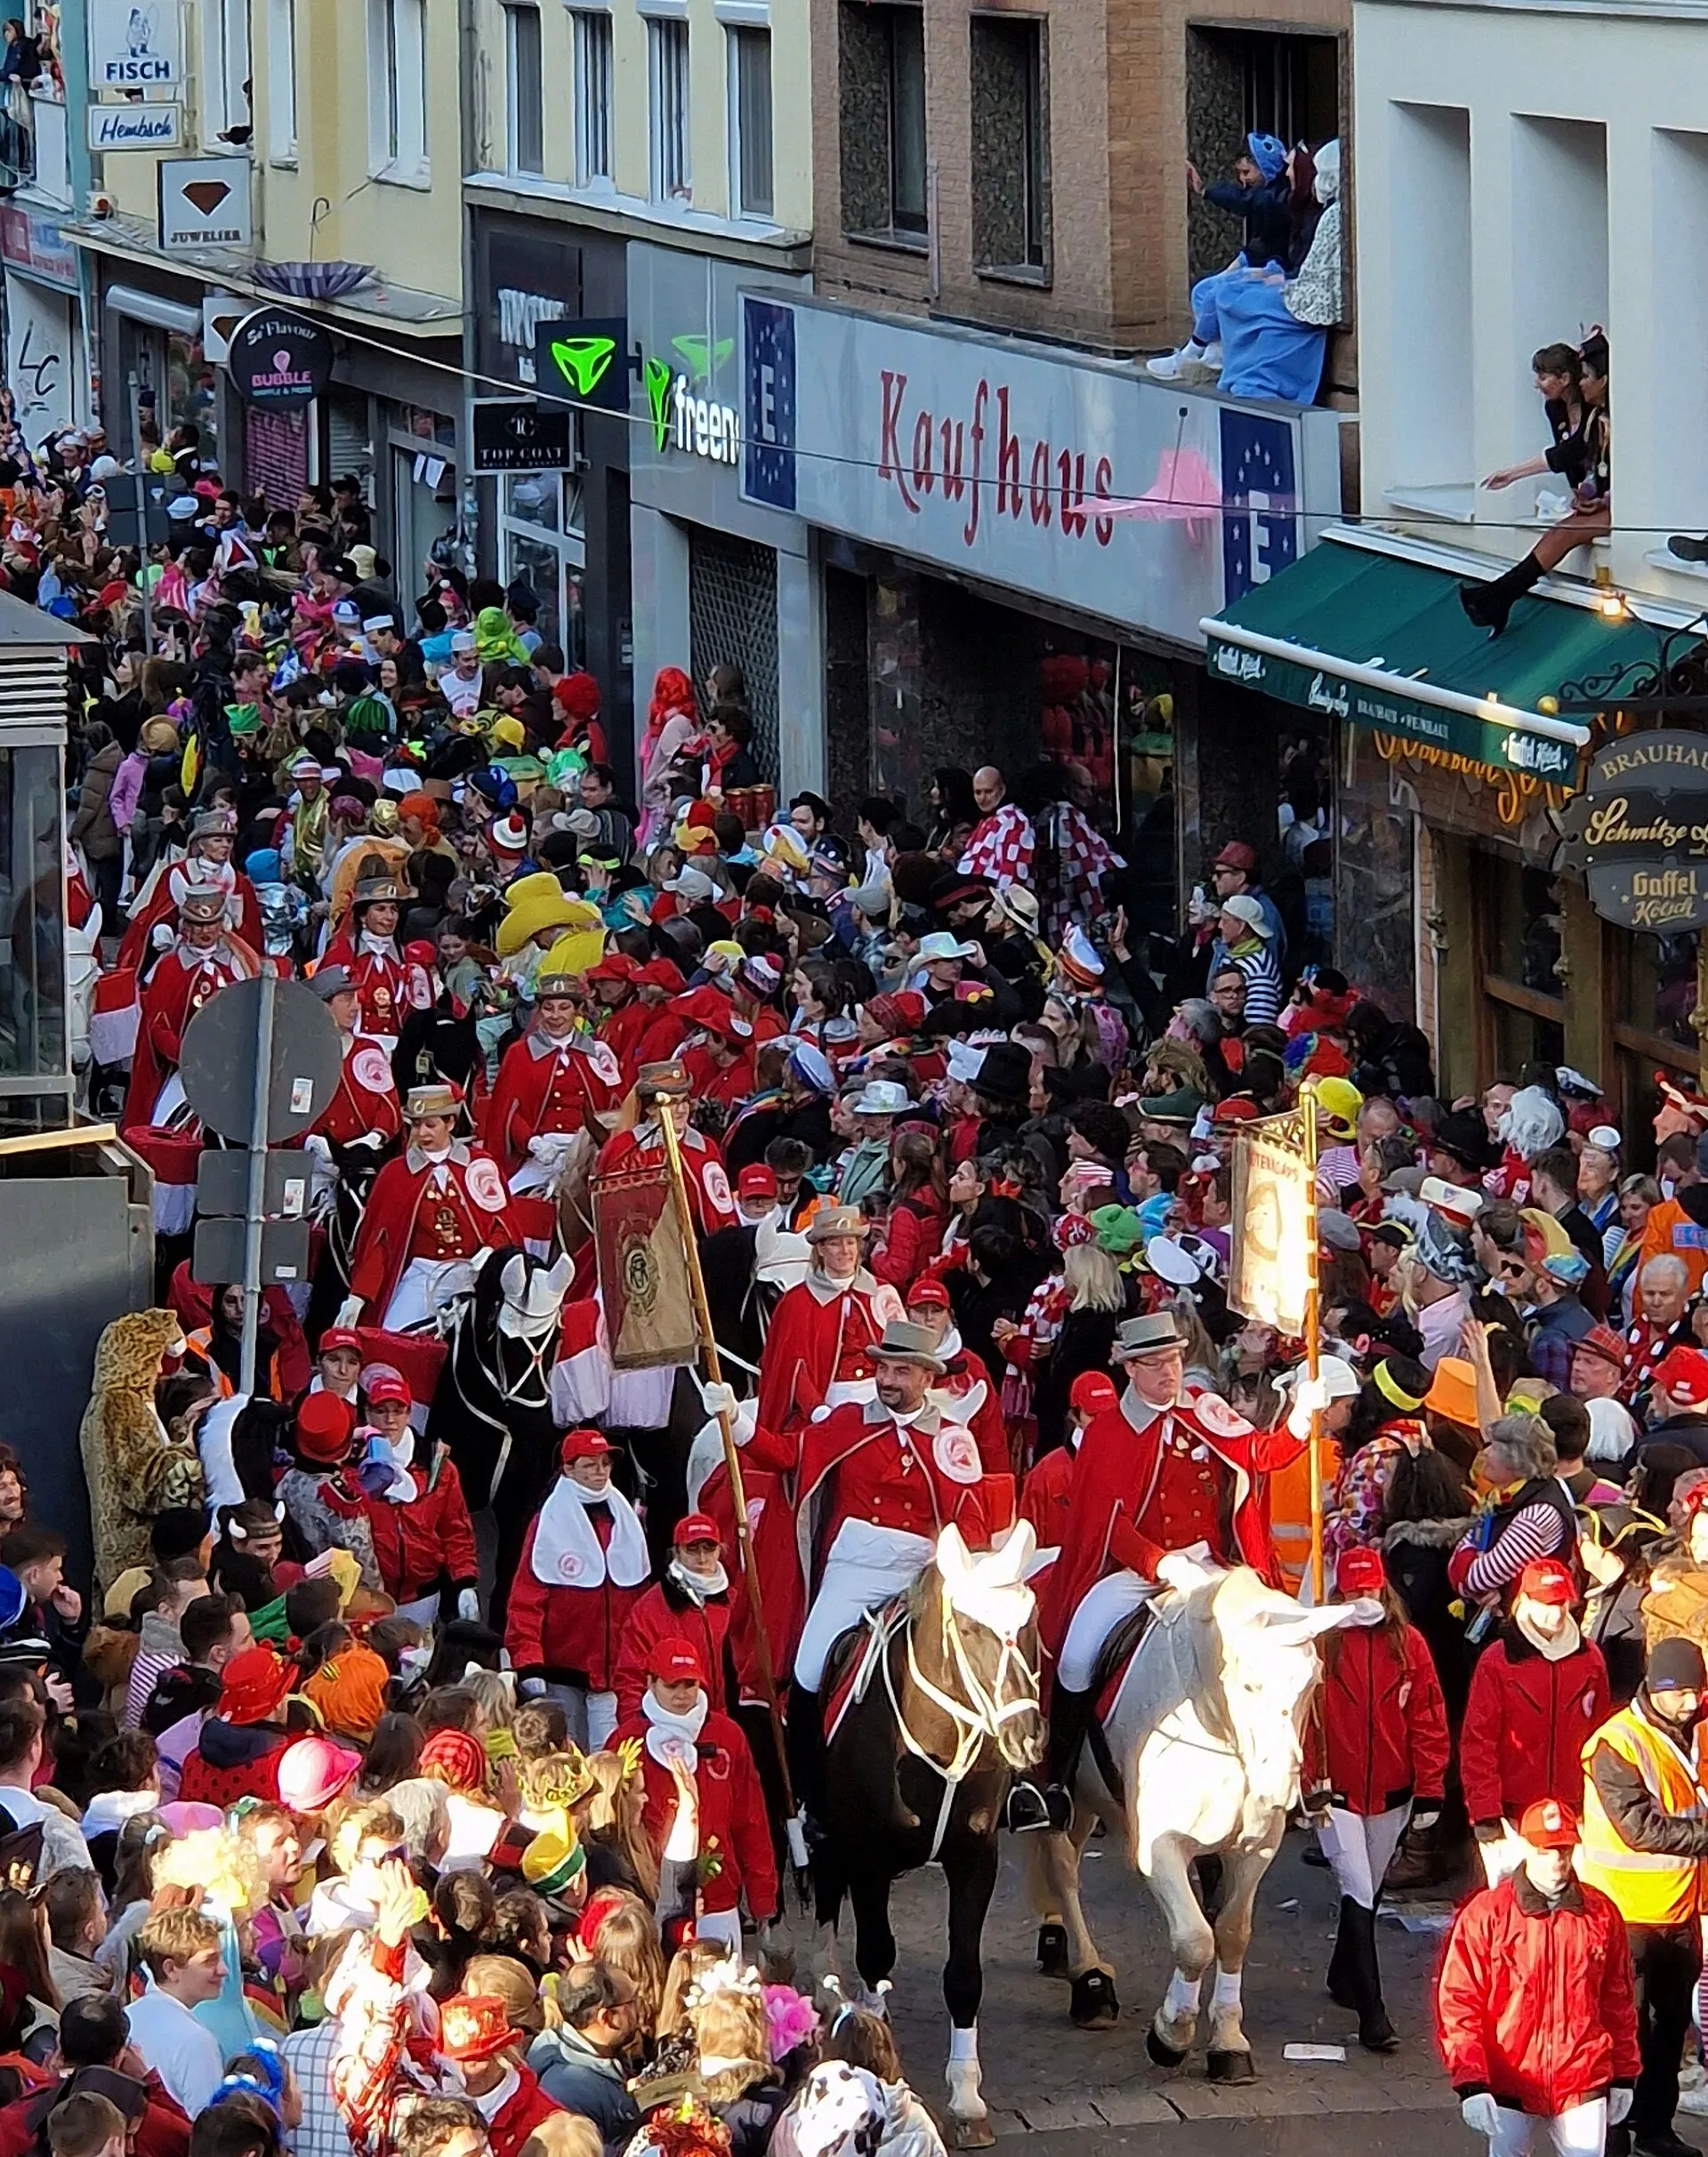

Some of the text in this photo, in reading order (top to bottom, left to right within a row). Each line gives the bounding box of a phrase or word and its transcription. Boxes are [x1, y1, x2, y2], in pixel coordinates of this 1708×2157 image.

[106, 60, 170, 80] FISCH
[171, 229, 240, 244] JUWELIER
[252, 371, 312, 387] BUBBLE
[673, 374, 739, 464] freen
[480, 447, 563, 461] TOP COAT
[878, 370, 1113, 546] Kaufhaus
[1584, 797, 1688, 848] Schmitze
[1633, 870, 1698, 898] Gaffel
